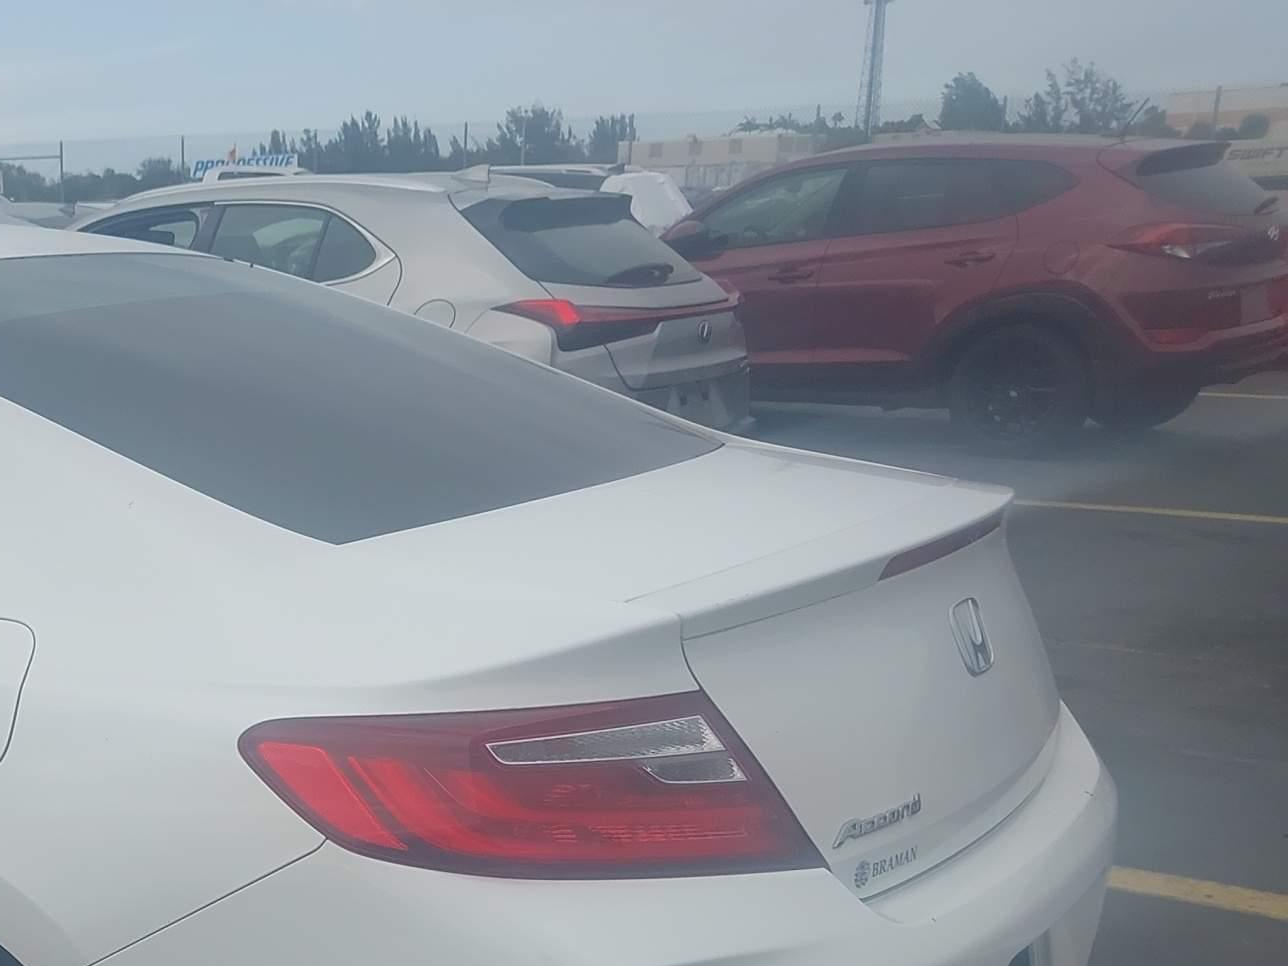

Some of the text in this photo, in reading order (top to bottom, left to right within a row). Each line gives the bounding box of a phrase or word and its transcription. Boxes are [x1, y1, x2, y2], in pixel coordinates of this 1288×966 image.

[192, 154, 294, 176] PRRESSIVE
[832, 792, 922, 849] Accord
[871, 845, 918, 879] BRAMAN
